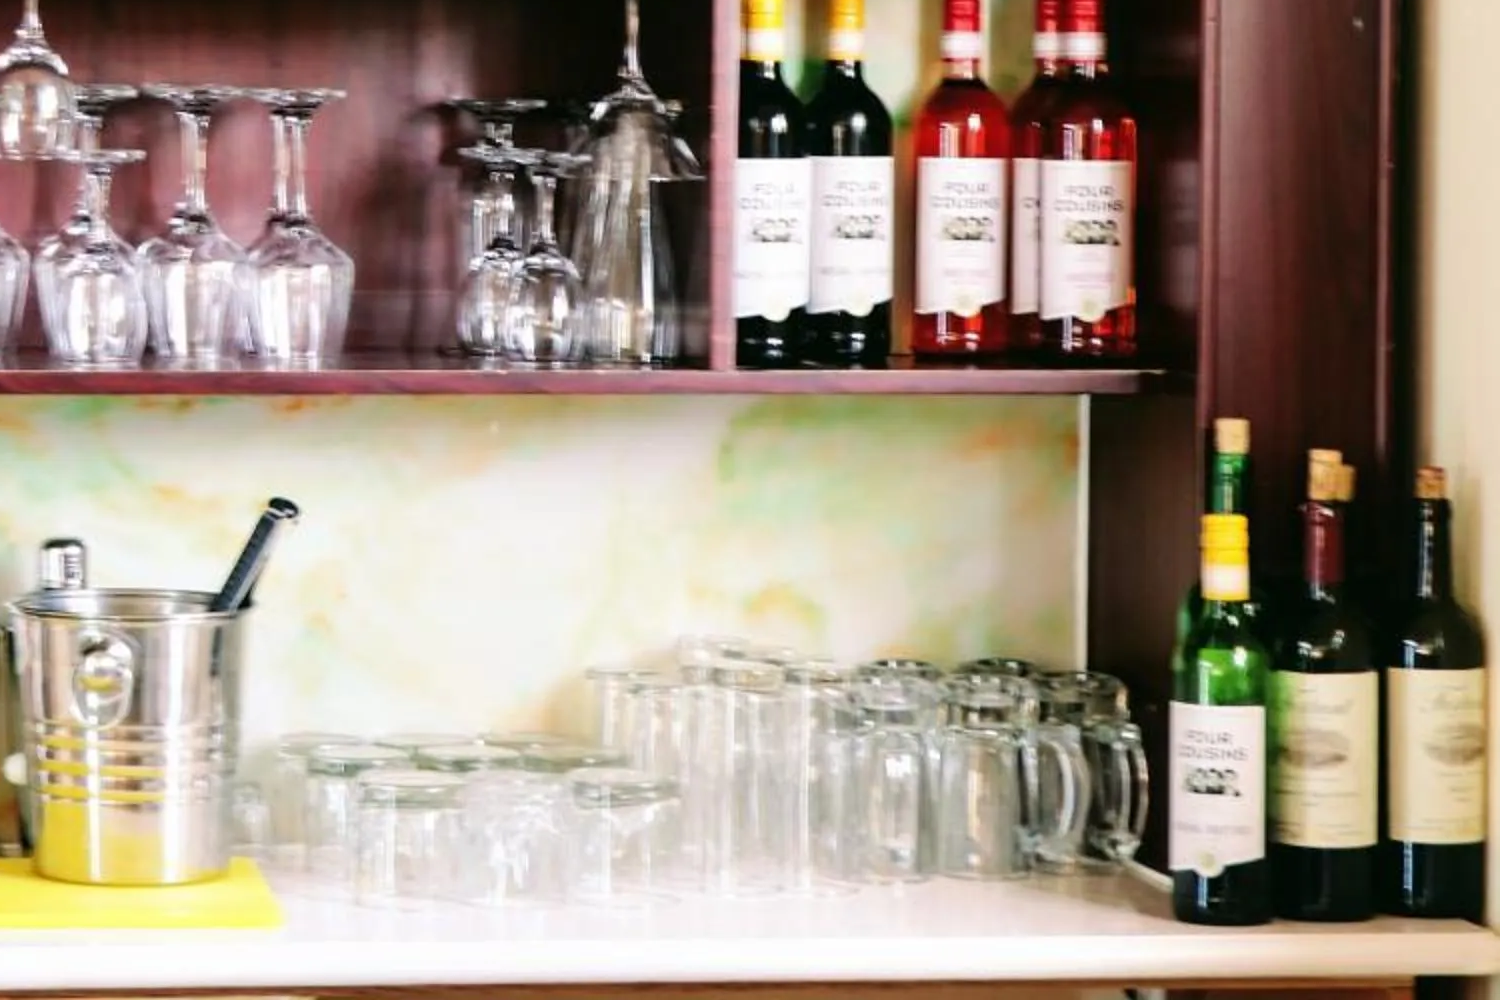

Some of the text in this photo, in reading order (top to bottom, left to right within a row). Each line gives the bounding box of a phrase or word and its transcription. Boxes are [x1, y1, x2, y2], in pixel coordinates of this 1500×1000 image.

[1063, 184, 1116, 198] FOUR
[1052, 198, 1125, 213] COUSINS
[1186, 728, 1235, 744] FOUR
[1177, 744, 1250, 761] COUSINS
